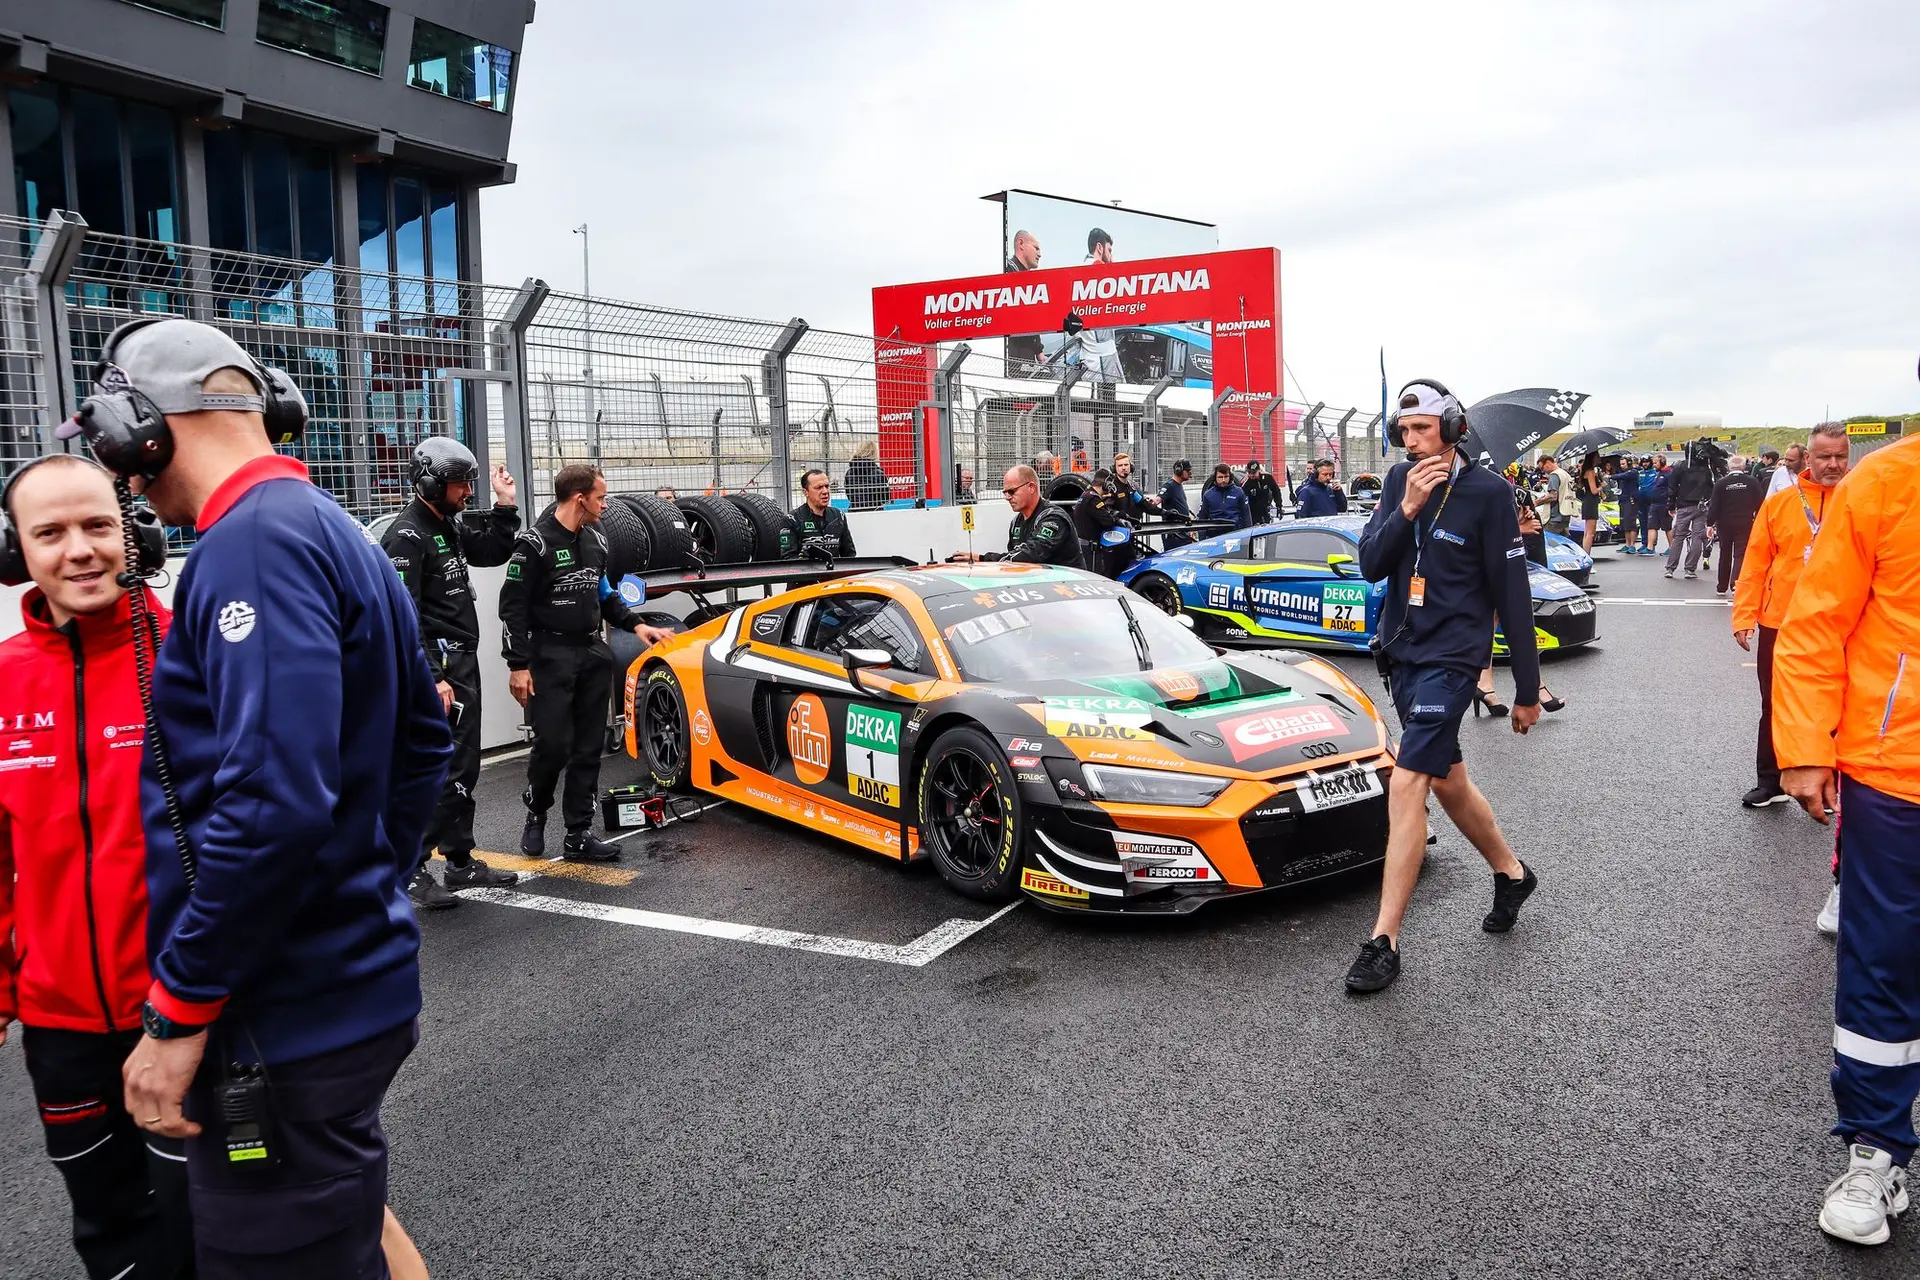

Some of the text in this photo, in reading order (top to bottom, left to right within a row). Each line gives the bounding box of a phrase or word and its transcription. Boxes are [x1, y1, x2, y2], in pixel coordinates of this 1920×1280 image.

[1072, 269, 1210, 301] MONTANA
[924, 284, 1049, 315] MONTANA
[1072, 301, 1147, 316] Voller Energie
[925, 315, 992, 329] Voller Energie
[1216, 320, 1270, 331] MONTANA
[878, 347, 922, 358] MONTANA
[1219, 392, 1272, 403] ONTANA
[881, 412, 925, 422] MONTA
[1516, 431, 1541, 451] ADAC
[965, 511, 971, 524] 8
[997, 588, 1045, 604] dvs
[1073, 584, 1114, 596] dvs
[1324, 587, 1364, 602] DEKRA
[1334, 605, 1353, 620] 27
[1330, 620, 1356, 631] ADAC
[791, 701, 828, 768] ifm
[846, 711, 897, 745] DEKRA
[1066, 723, 1137, 740] ADAC
[1089, 750, 1118, 760] Land
[867, 751, 874, 778] 1
[1017, 773, 1045, 781] STALOC
[858, 778, 889, 804] ADAC
[999, 796, 1014, 872] P ZERO
[1149, 868, 1194, 878] FERODO
